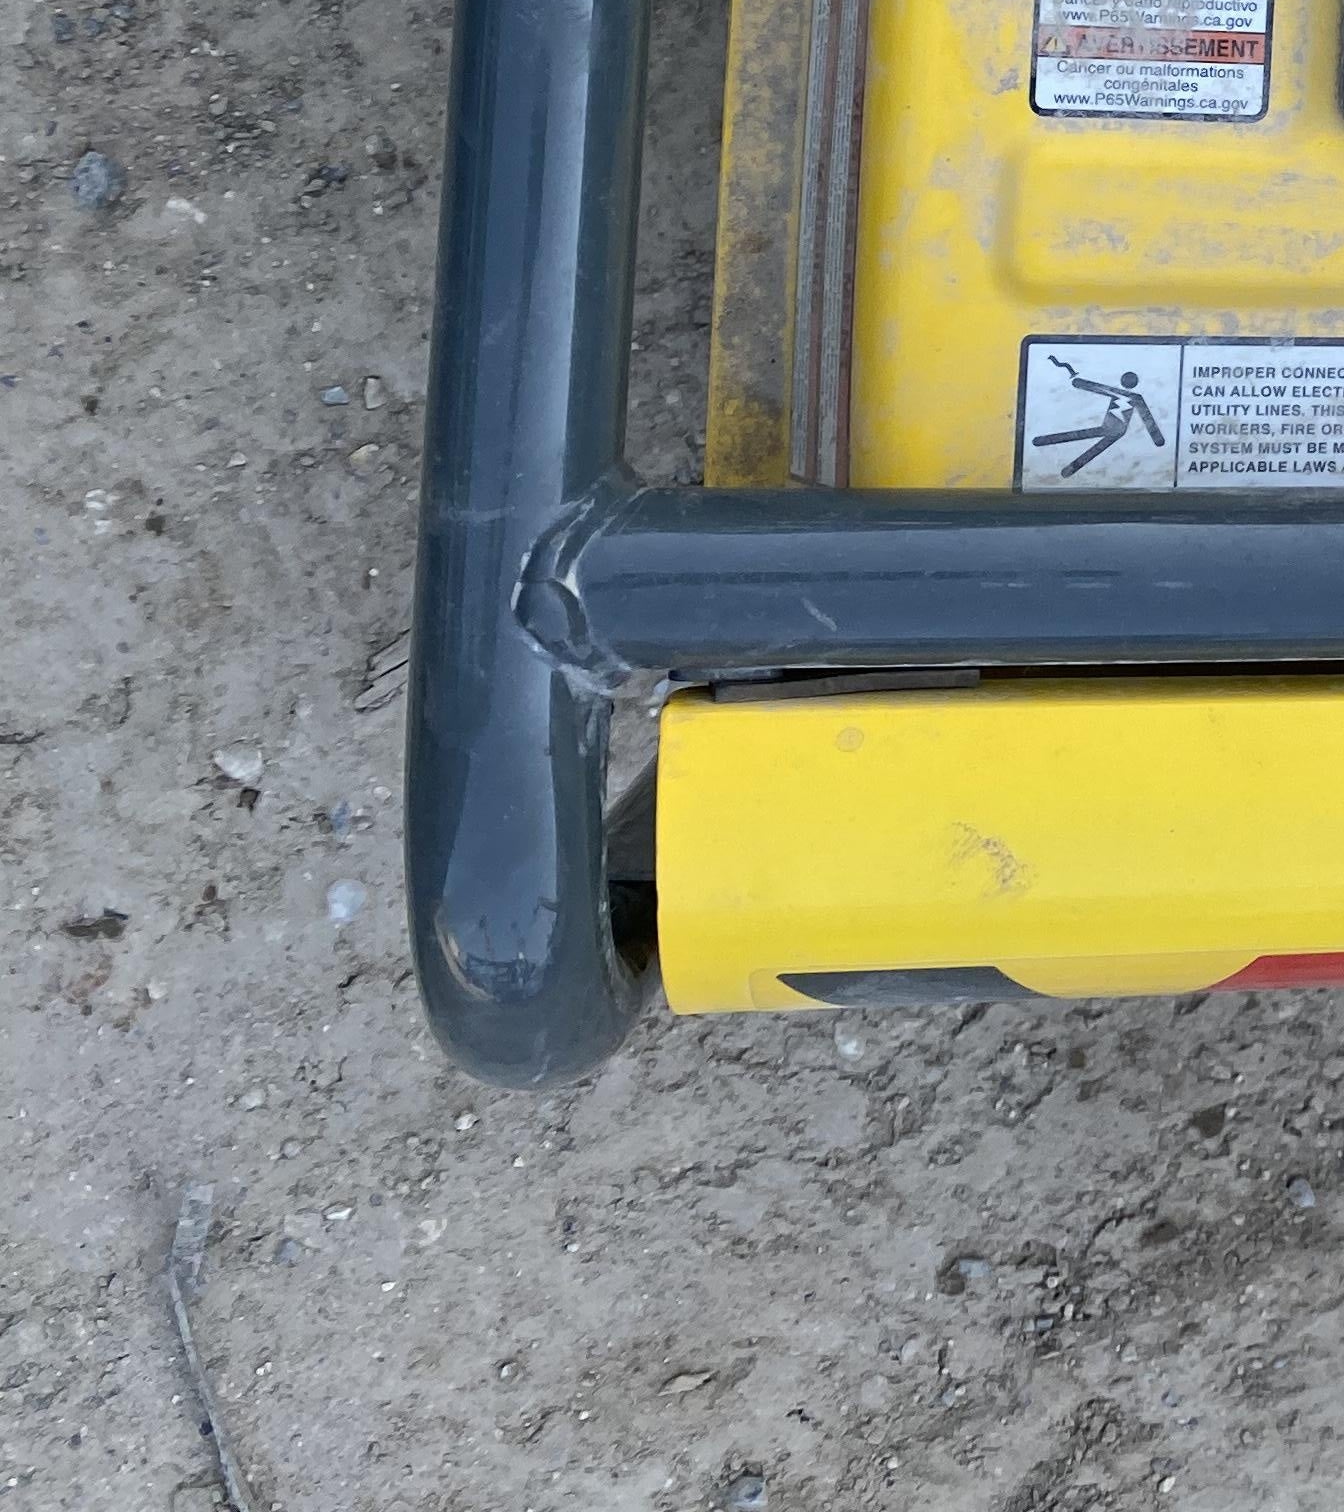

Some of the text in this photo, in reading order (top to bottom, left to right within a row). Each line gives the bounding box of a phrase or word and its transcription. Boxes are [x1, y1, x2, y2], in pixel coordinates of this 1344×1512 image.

[1116, 64, 1134, 75] ou
[1139, 64, 1244, 79] malformations
[1103, 78, 1199, 94] congénitales
[1053, 92, 1248, 112] www.P65Warnings.ca.gov
[1192, 366, 1276, 379] IMPROPER
[1191, 385, 1225, 398] CAN
[1228, 386, 1286, 398] ALLOW
[1191, 404, 1250, 417] UTILITY
[1254, 404, 1304, 417] LINES.
[1190, 423, 1275, 438] WORKERS,
[1279, 423, 1316, 436] FIRE
[1320, 424, 1343, 436] OR
[1188, 442, 1253, 454] SYSTEM
[1257, 442, 1301, 454] MUST
[1305, 442, 1327, 454] BE
[1188, 460, 1287, 473] APPLICABLE
[1292, 461, 1337, 473] LAWS
